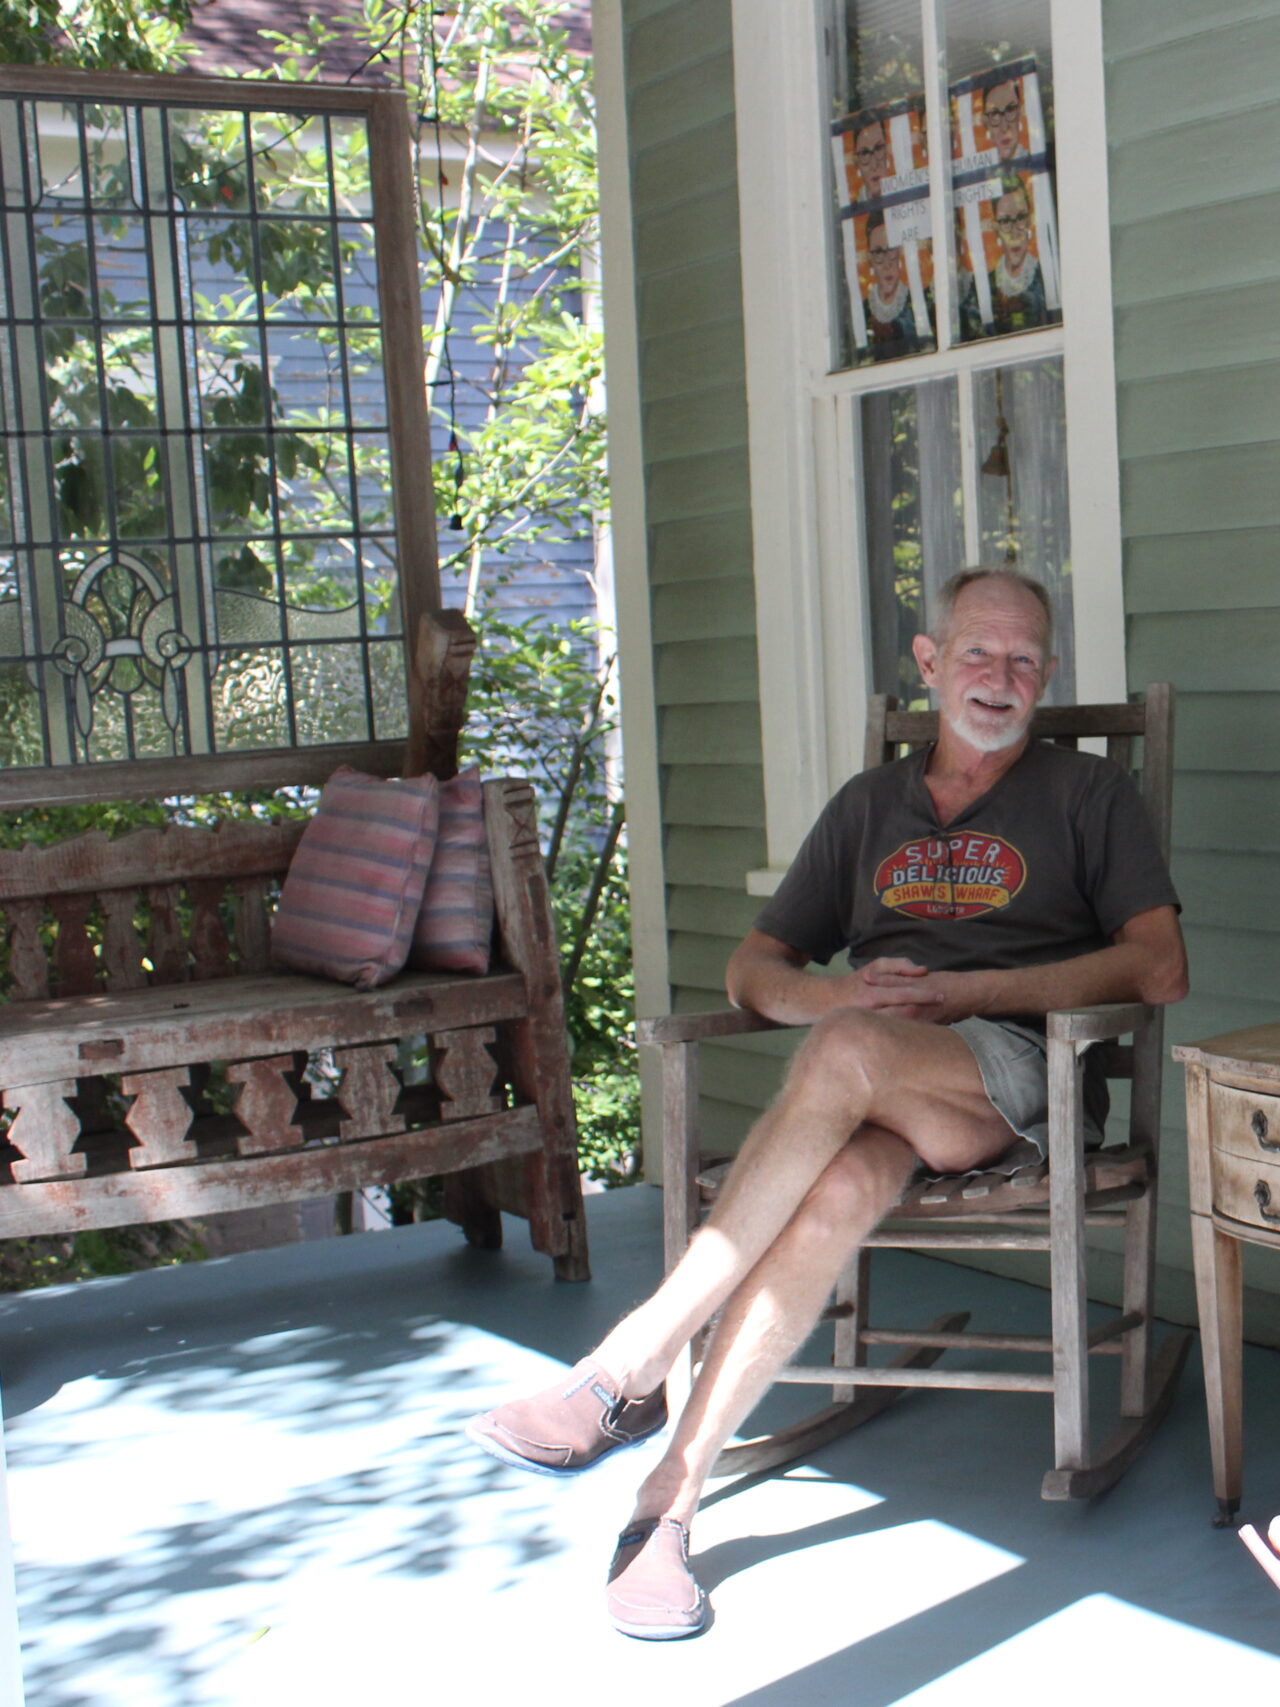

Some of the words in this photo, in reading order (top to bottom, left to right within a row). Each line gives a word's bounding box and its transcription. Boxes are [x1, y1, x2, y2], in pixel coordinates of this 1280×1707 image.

[953, 153, 992, 172] HUMAN
[956, 184, 994, 204] RIGHTS
[891, 199, 926, 221] RIGHTS
[902, 226, 918, 241] ARE
[905, 839, 1001, 863] SUPER
[893, 864, 1006, 886] DELICIOUS
[956, 886, 1000, 901] WHARF
